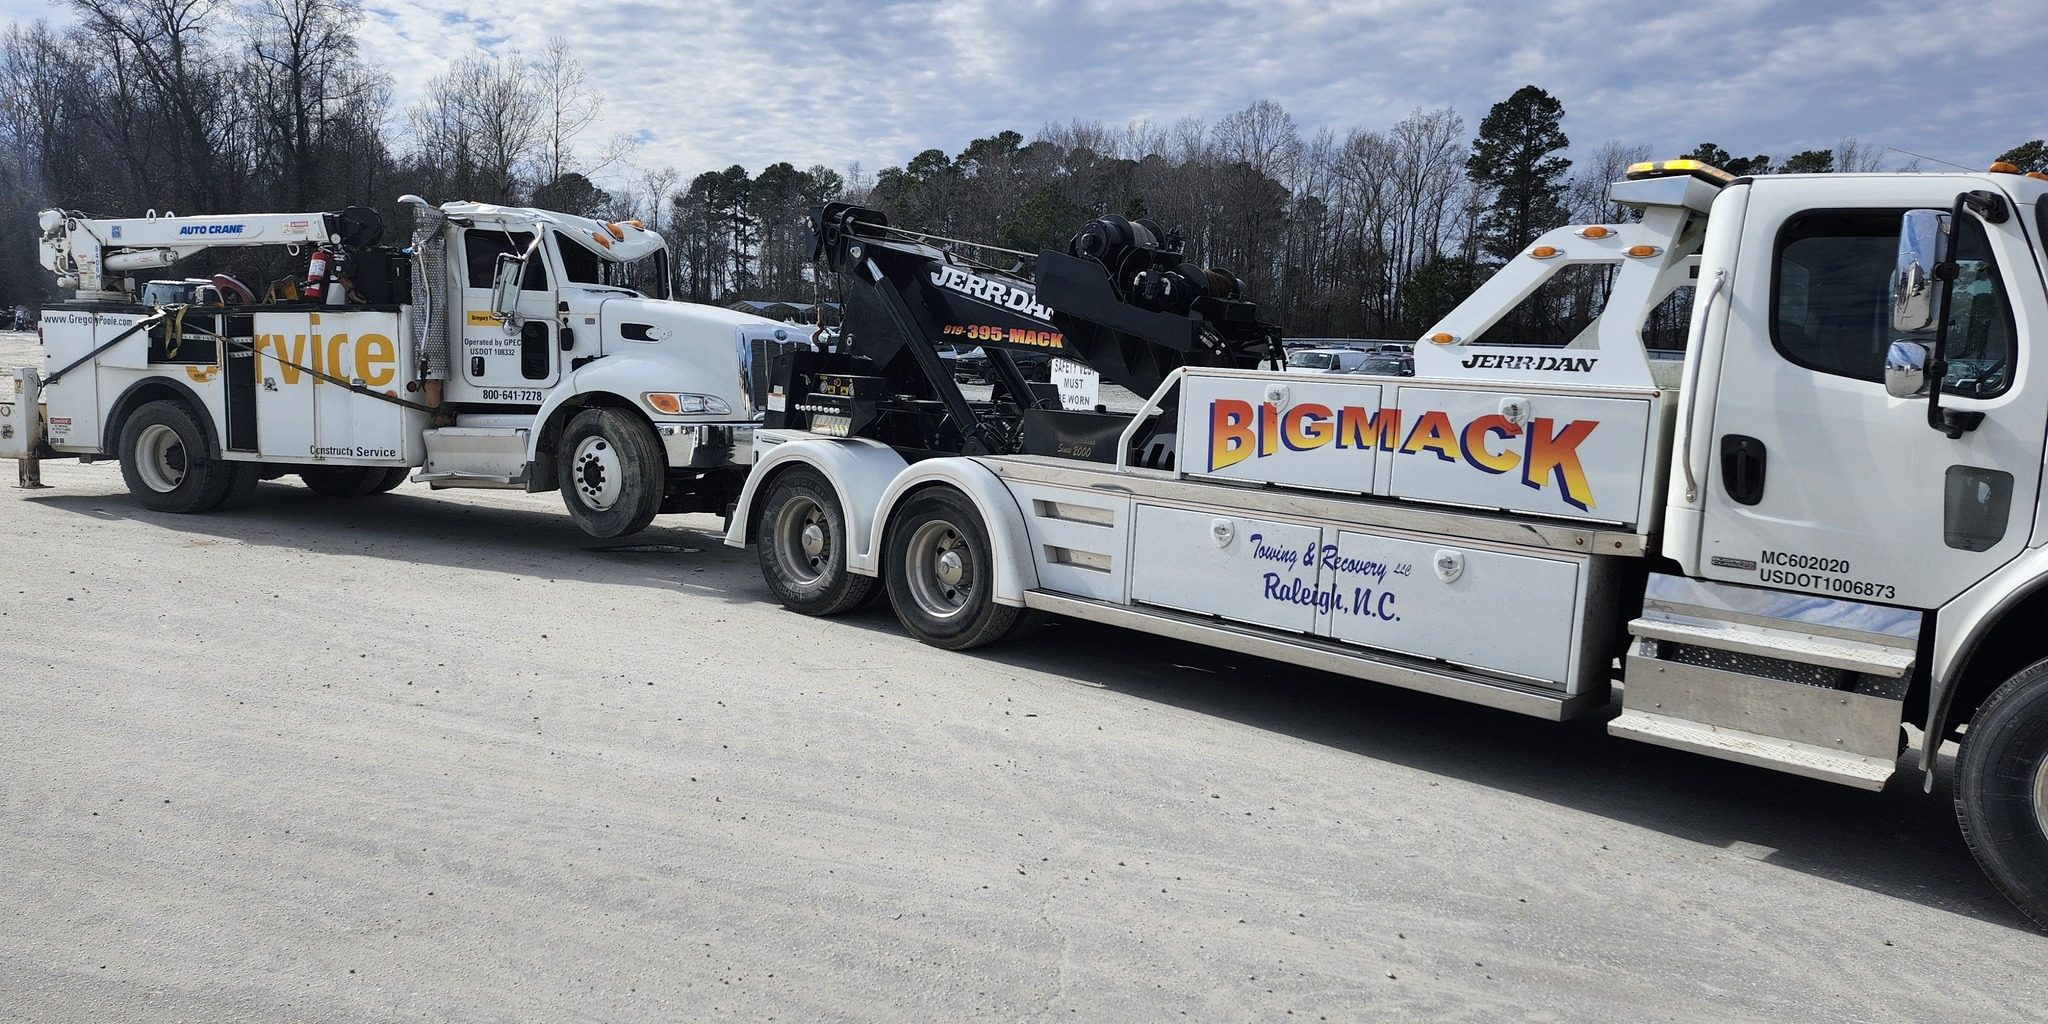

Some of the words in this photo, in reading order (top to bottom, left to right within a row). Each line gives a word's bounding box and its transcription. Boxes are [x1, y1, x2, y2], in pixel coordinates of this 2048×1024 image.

[179, 226, 206, 235] AUTO
[208, 224, 244, 234] CRANE
[43, 313, 133, 327] www.GregoyPoole.com
[464, 338, 493, 347] Operated
[494, 338, 503, 347] by
[503, 338, 522, 346] GPEC
[1461, 354, 1599, 373] JERR-DAN
[1063, 378, 1084, 389] MUST
[482, 389, 542, 401] 800-641-7278
[1068, 394, 1090, 406] WORN
[356, 446, 396, 457] Service
[1072, 446, 1092, 457] 2000
[1207, 398, 1600, 513] BIGMACK
[1250, 533, 1298, 572] Towing
[1303, 542, 1316, 566] &
[1320, 544, 1387, 584] Recovery
[1393, 563, 1412, 577] LLC
[1761, 550, 1850, 574] MC602020
[1760, 568, 1896, 599] USDOT1006873
[1263, 572, 1349, 615] Raleigh,
[1353, 587, 1401, 622] N.C.
